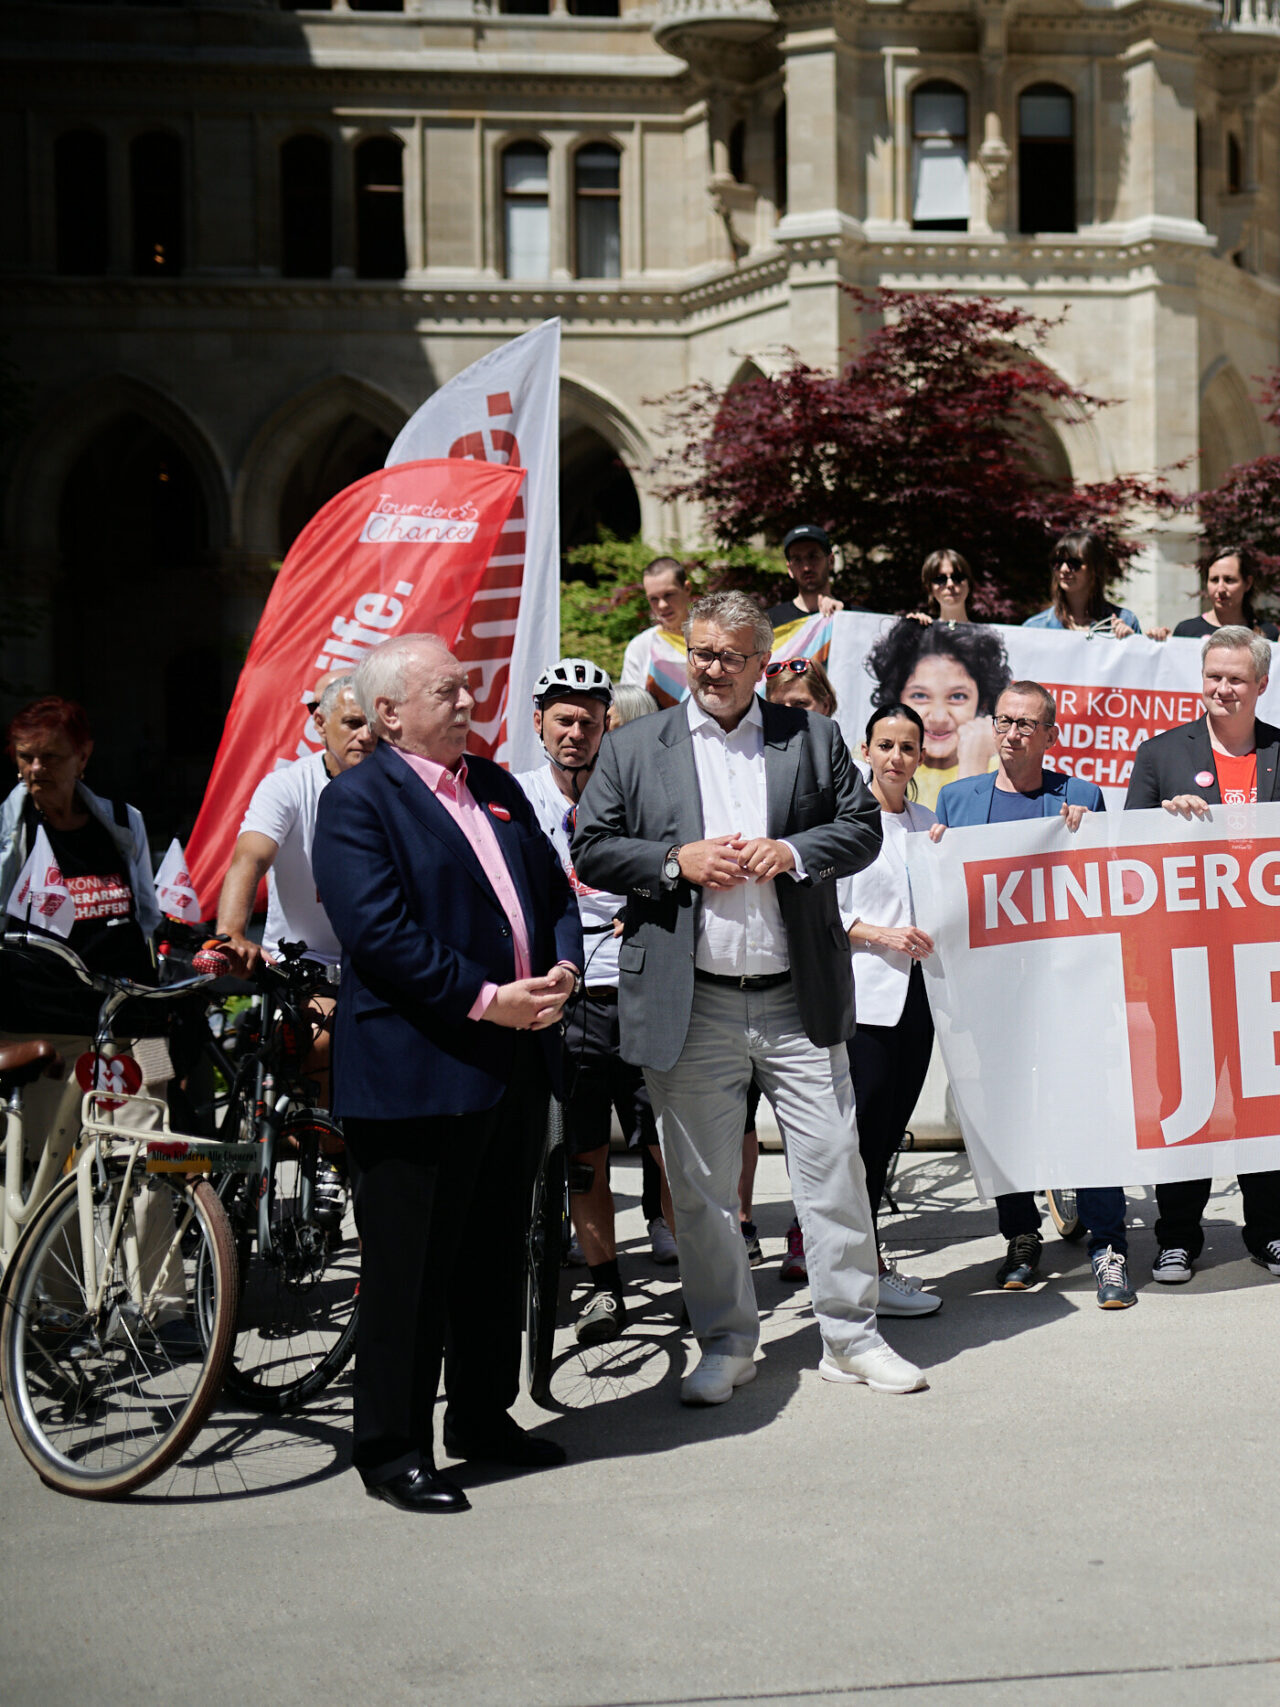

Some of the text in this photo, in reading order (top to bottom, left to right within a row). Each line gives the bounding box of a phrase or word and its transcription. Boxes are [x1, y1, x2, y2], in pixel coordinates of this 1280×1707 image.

[376, 493, 448, 517] Tour de
[366, 514, 475, 541] Chance
[1041, 754, 1136, 784] BSCHA
